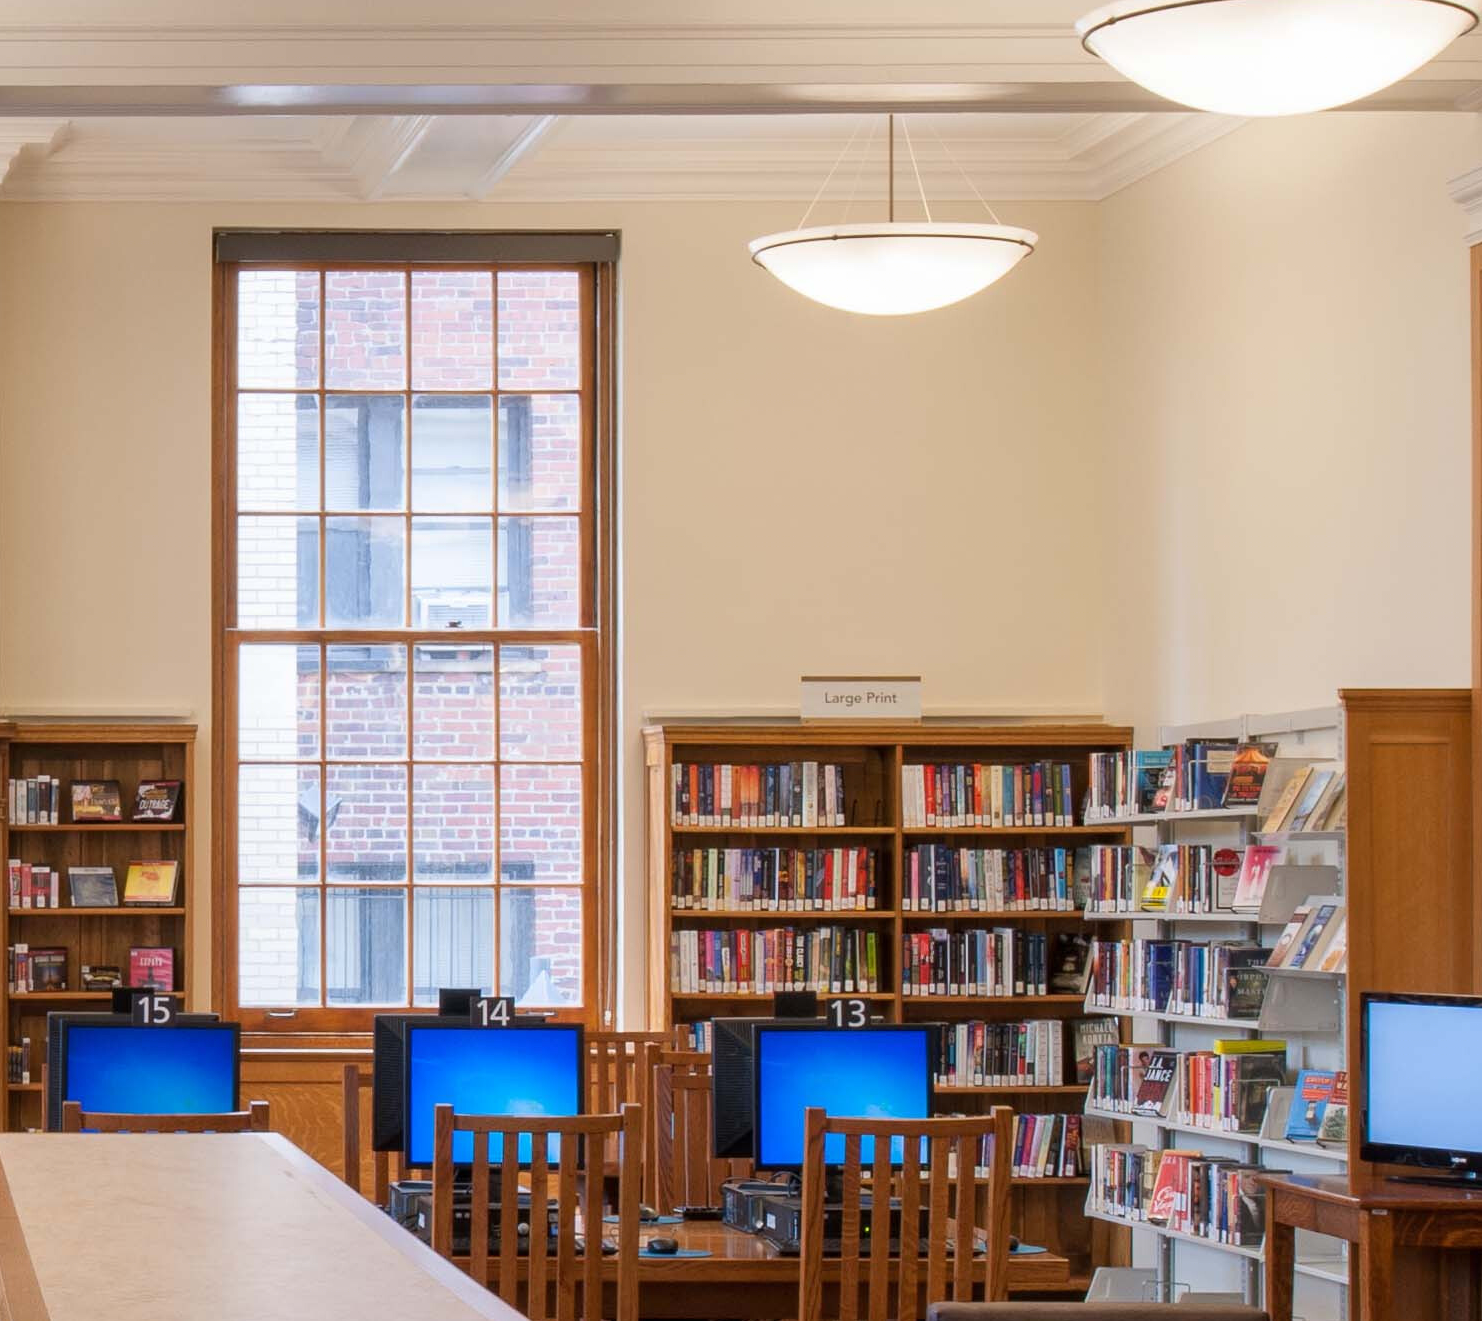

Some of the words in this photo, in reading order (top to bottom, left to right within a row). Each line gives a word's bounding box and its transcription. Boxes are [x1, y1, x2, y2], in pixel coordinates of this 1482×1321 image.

[824, 692, 862, 707] Large
[866, 692, 898, 704] Print
[138, 996, 171, 1024] 15
[477, 999, 511, 1027] 14
[831, 999, 867, 1028] 13
